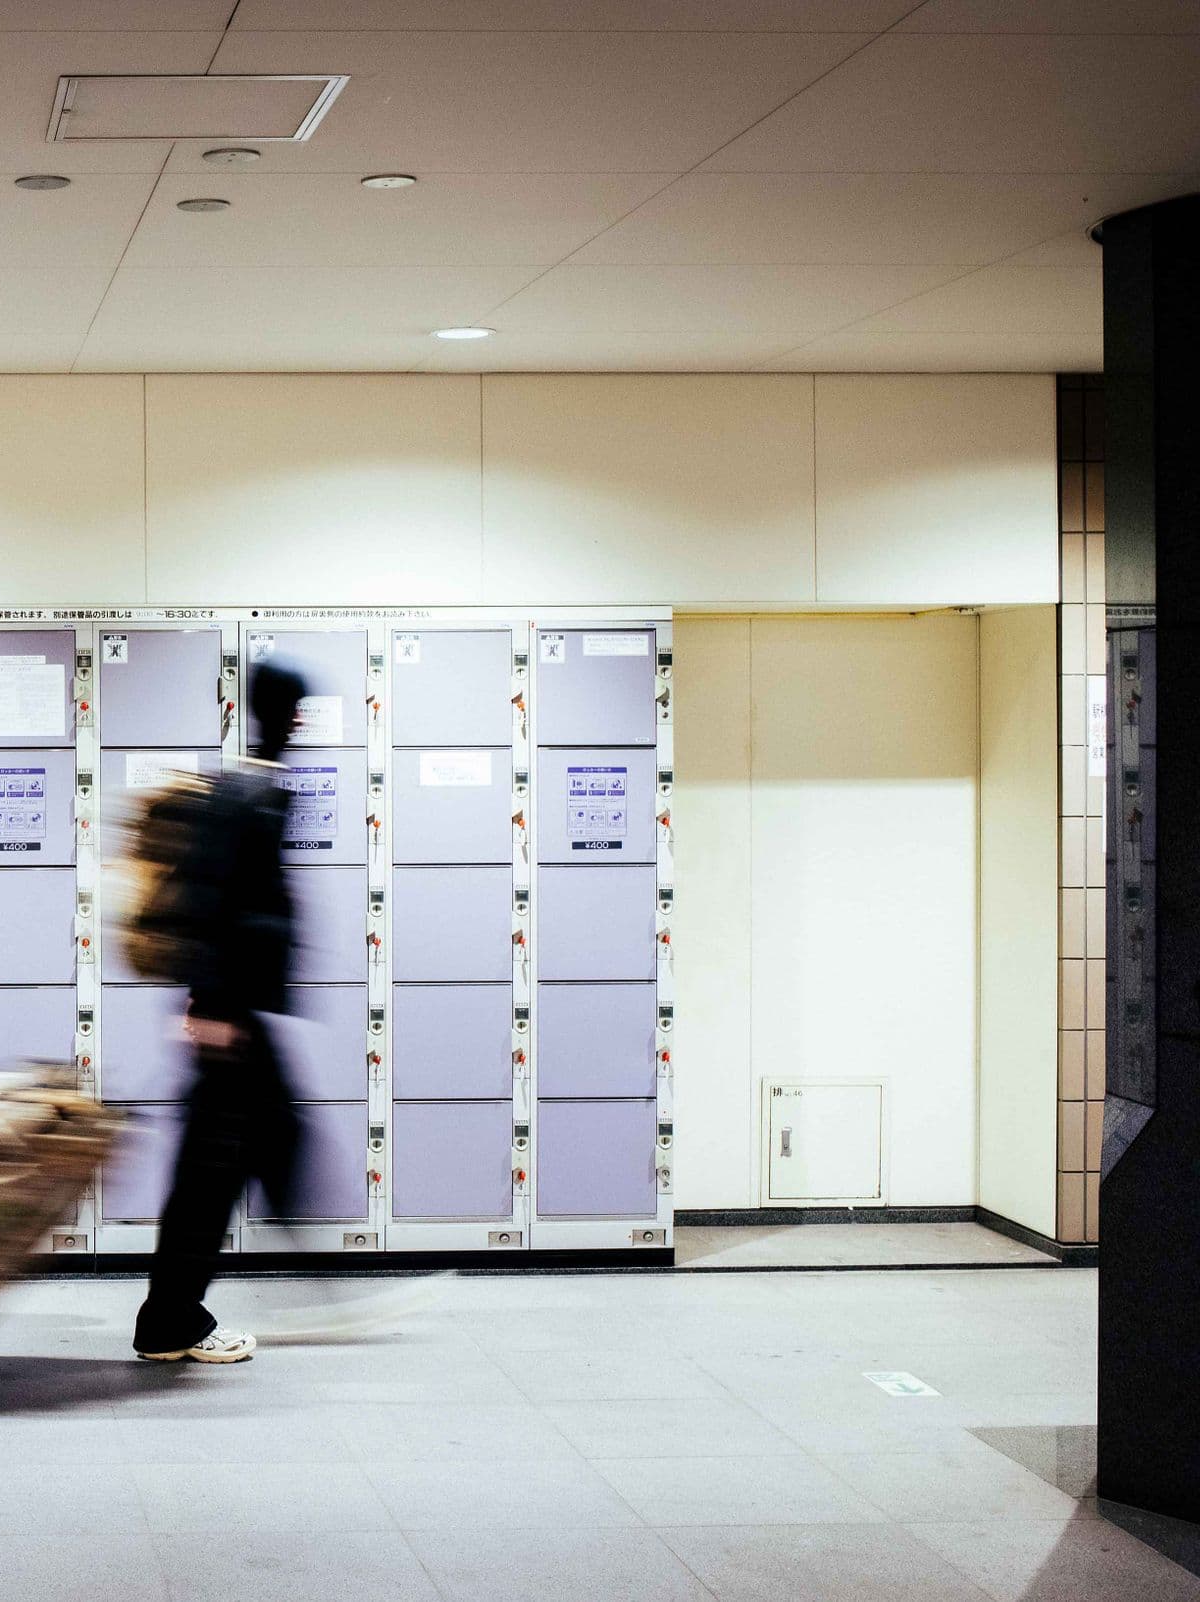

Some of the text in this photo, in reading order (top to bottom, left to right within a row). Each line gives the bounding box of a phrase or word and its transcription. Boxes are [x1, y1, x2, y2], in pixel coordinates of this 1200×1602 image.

[3, 843, 27, 851] ¥400
[295, 841, 319, 849] ¥400
[585, 841, 609, 849] ¥400
